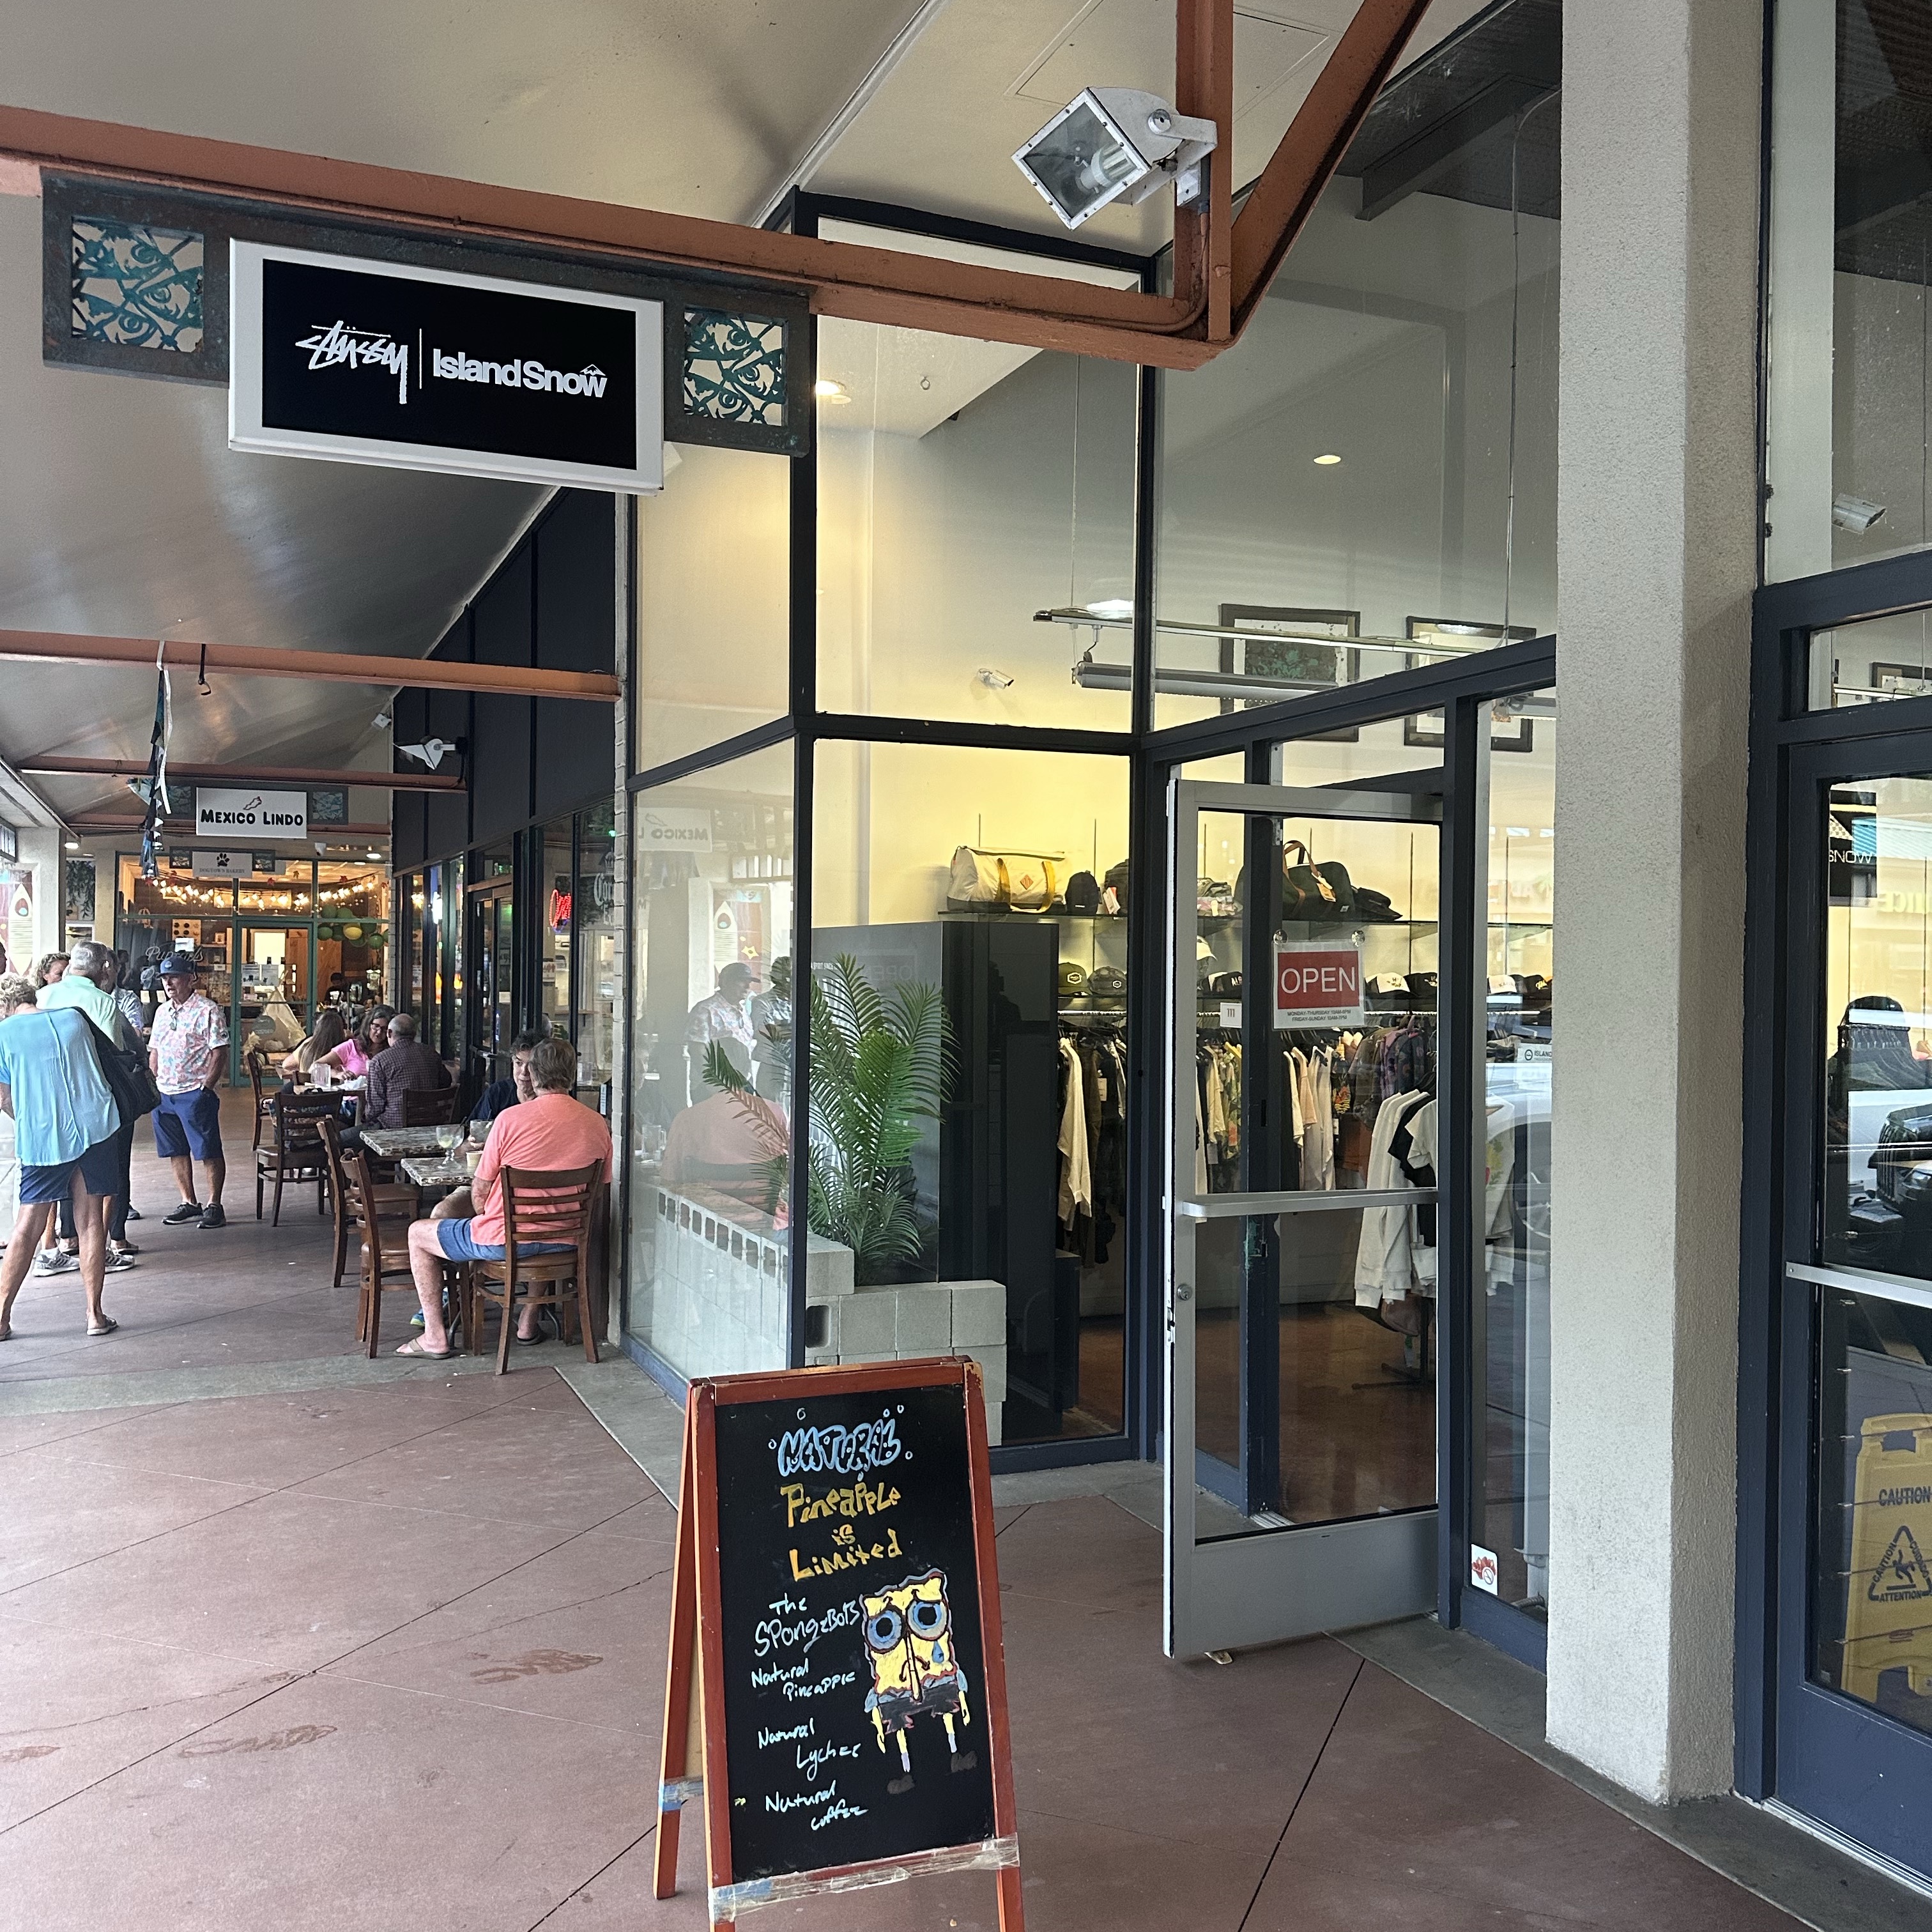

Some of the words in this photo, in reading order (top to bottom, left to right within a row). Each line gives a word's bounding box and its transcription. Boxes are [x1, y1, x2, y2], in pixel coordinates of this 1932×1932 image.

[201, 809, 256, 824] MEXICO
[263, 811, 303, 826] LINDO
[1281, 967, 1355, 994] OPEN
[1879, 1485, 1931, 1506] CAUTION
[751, 1658, 809, 1688] Natural
